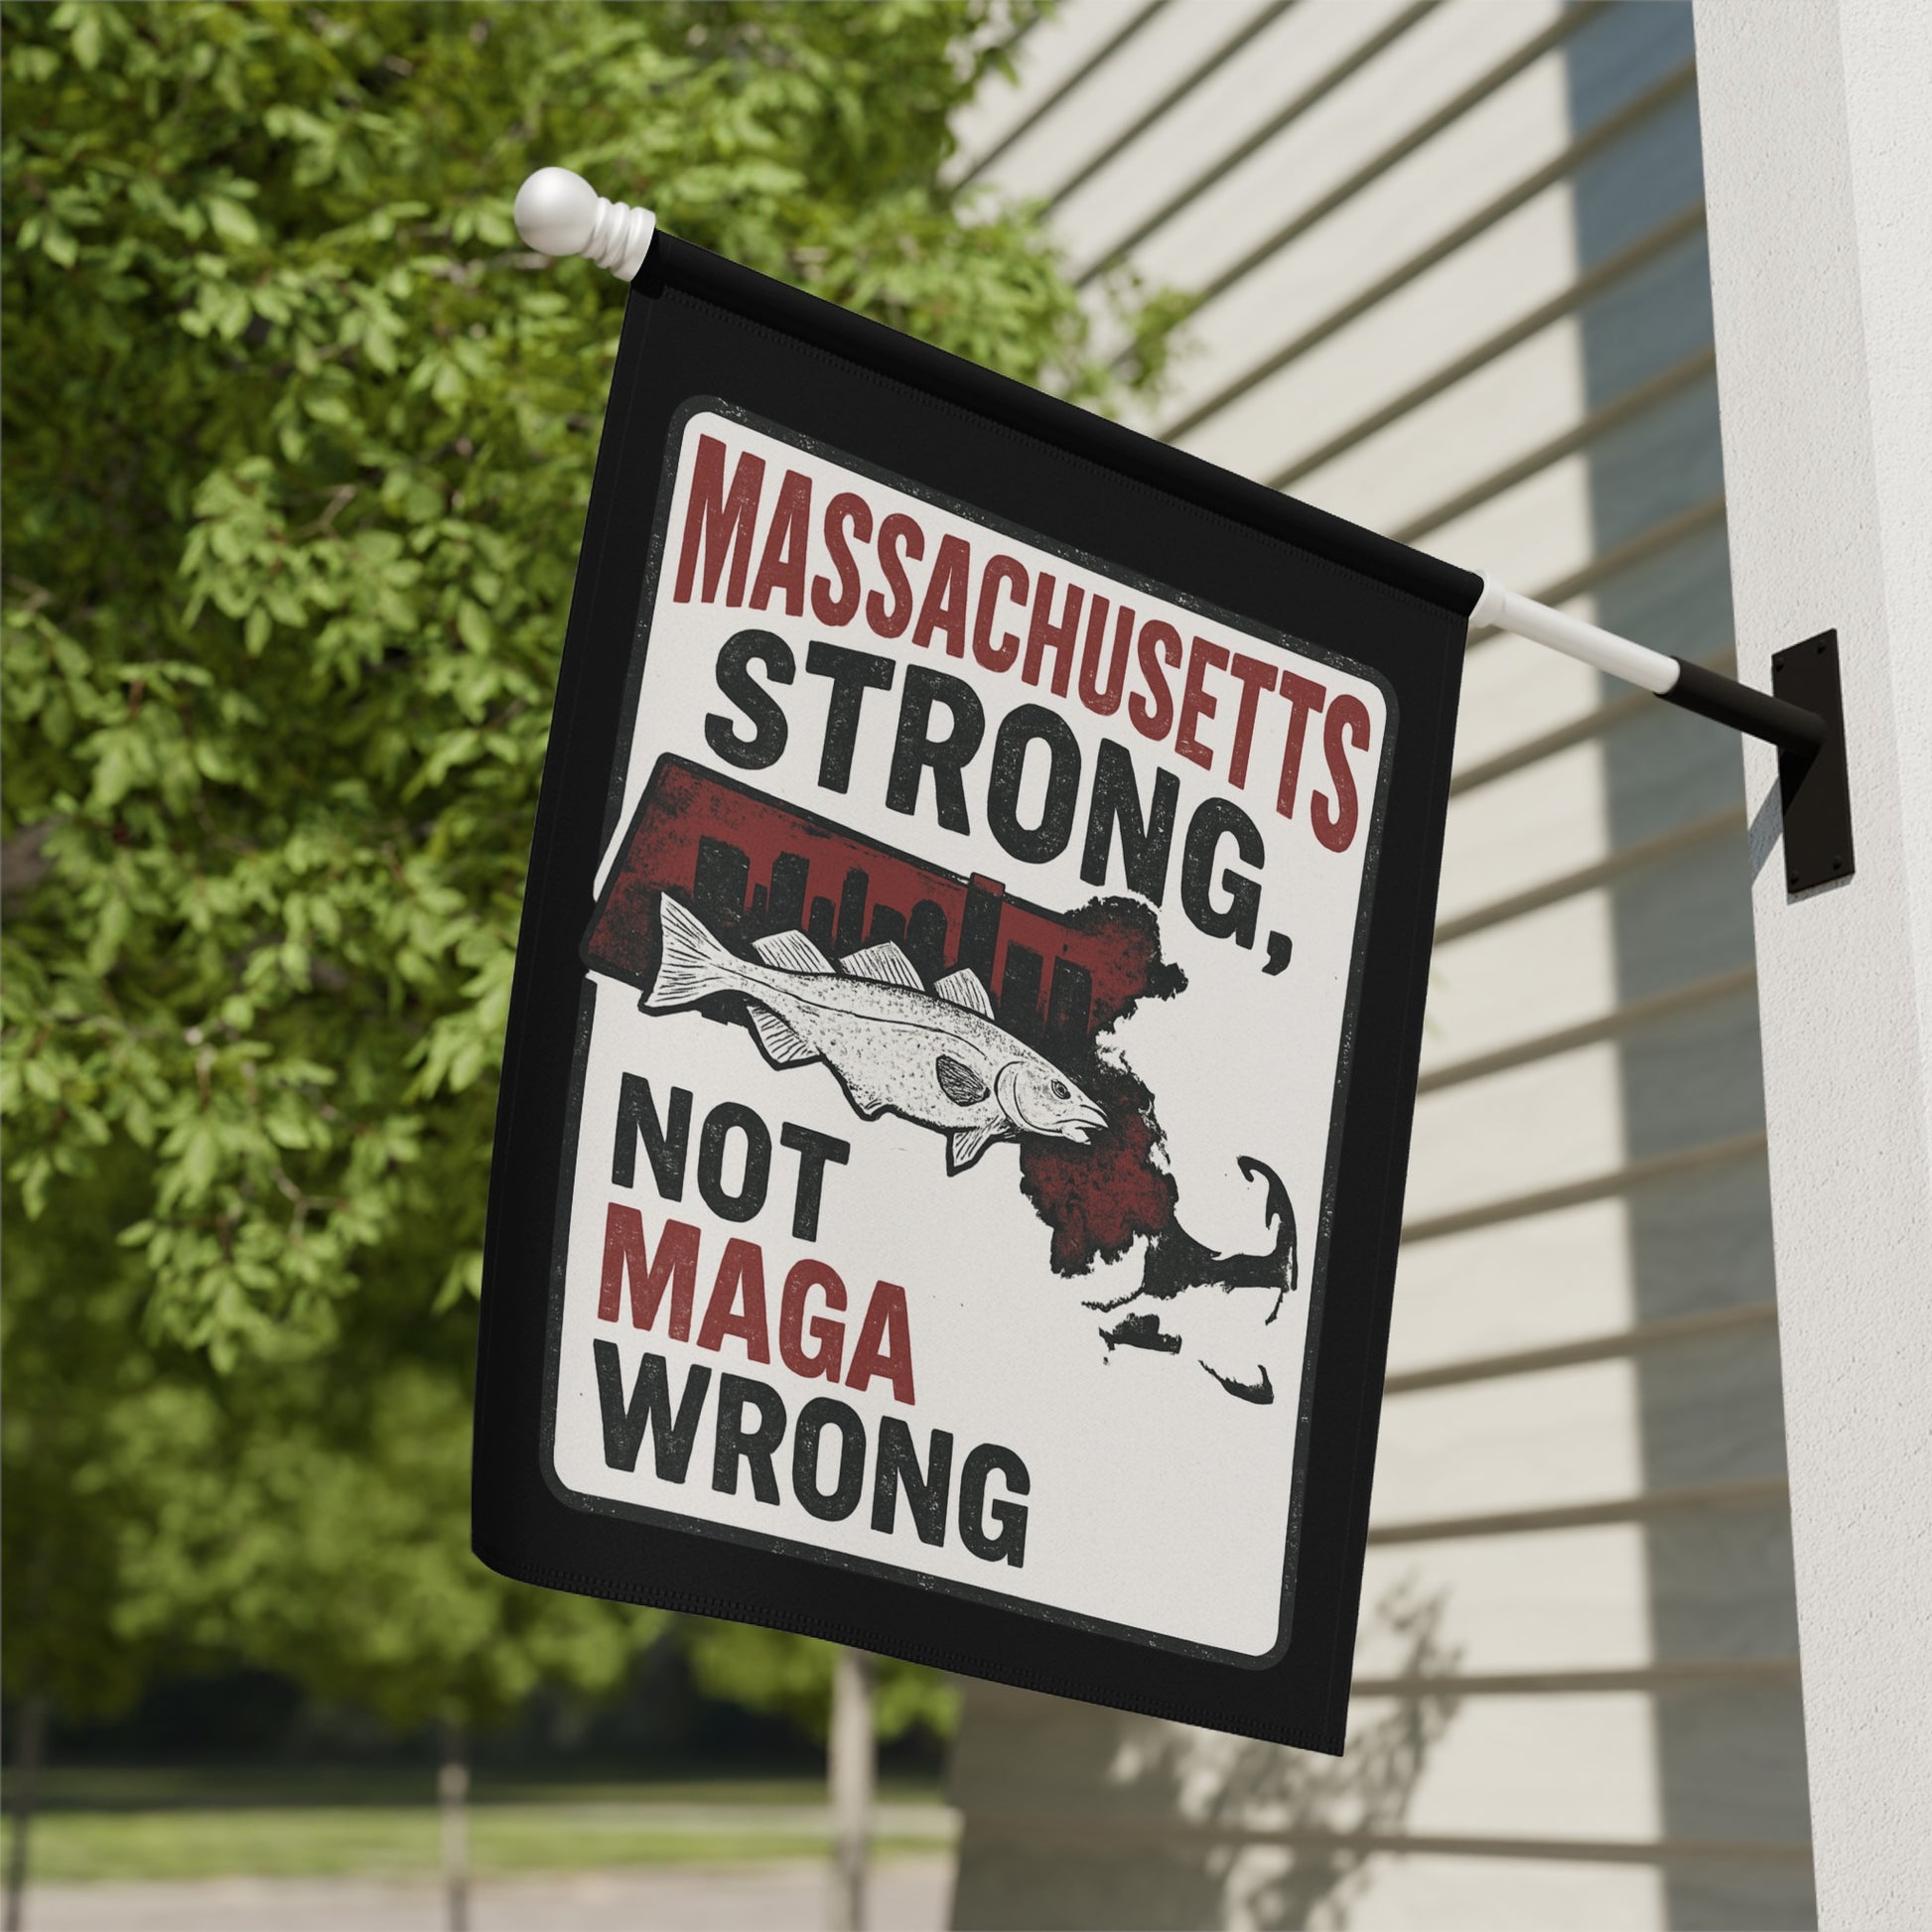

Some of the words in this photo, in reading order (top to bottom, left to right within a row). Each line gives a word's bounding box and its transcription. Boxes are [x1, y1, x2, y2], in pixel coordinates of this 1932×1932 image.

[673, 434, 1371, 852] MASSACHUSETTS
[704, 628, 1293, 975] STRONG,
[612, 1071, 851, 1242] NOT
[598, 1202, 915, 1406] MAGA
[593, 1339, 1031, 1569] WRONG
